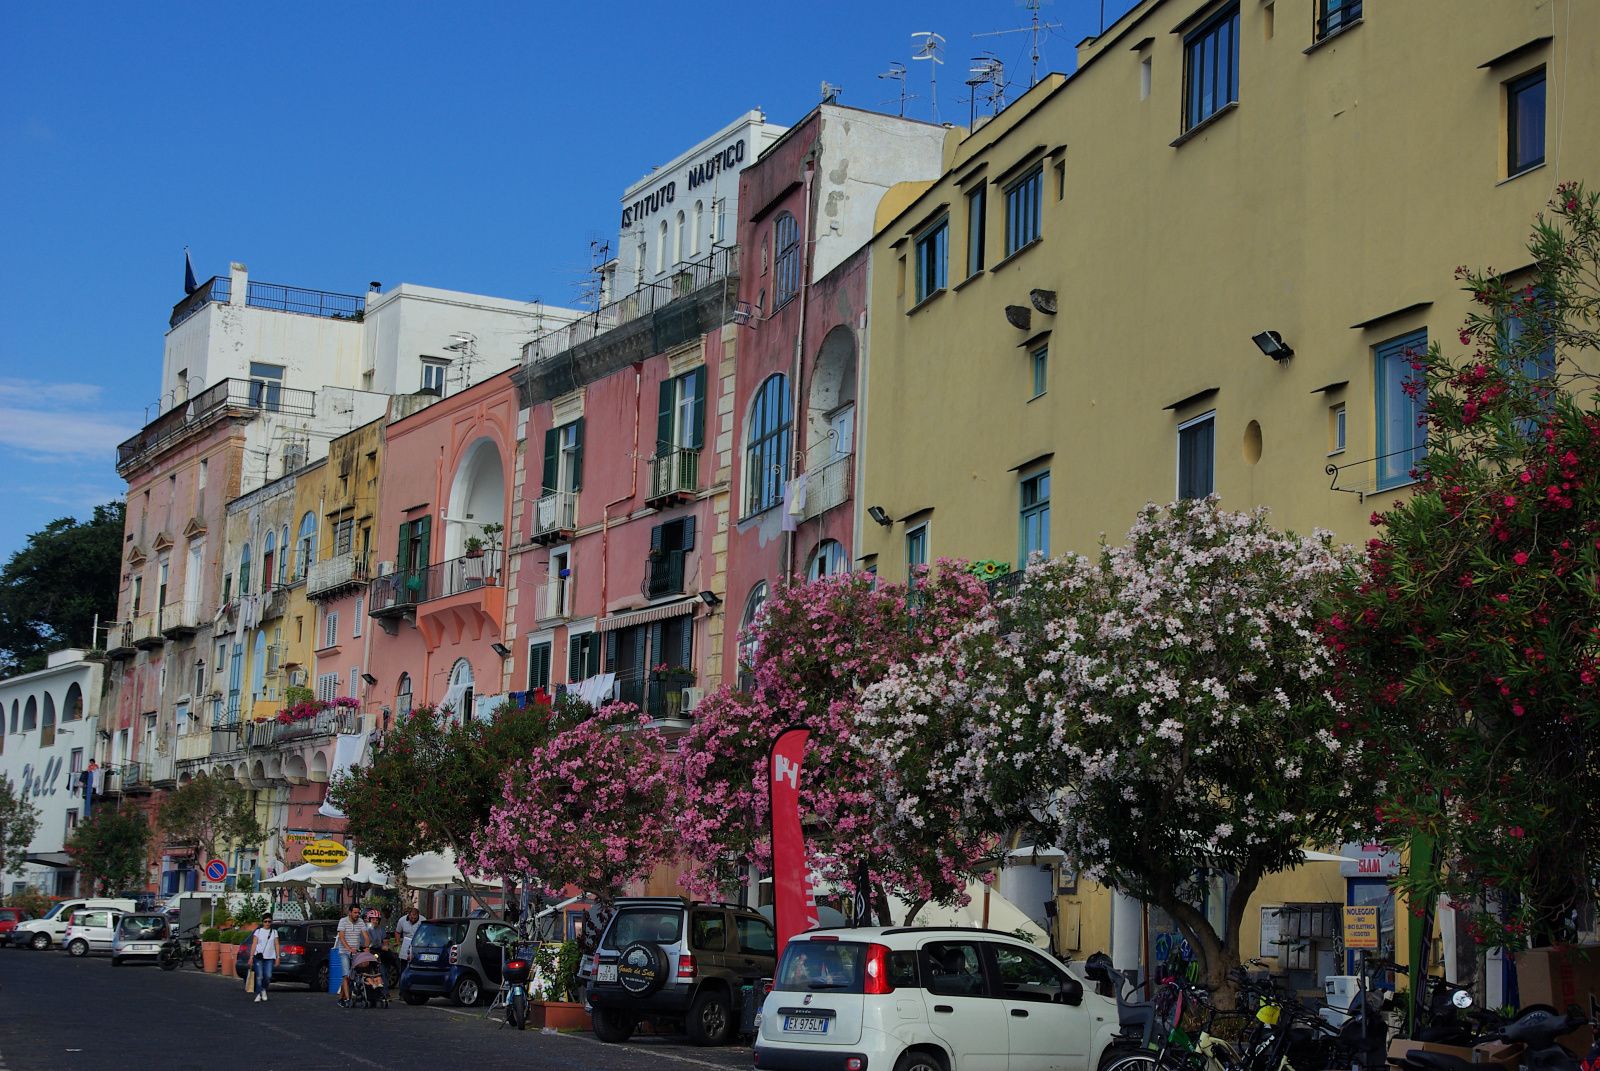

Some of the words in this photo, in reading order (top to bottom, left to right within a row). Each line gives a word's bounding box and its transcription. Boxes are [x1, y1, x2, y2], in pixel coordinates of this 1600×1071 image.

[621, 181, 676, 228] ISTITUTO
[688, 139, 745, 190] NAUTICO
[1359, 858, 1381, 873] SLAM
[789, 1018, 799, 1030] EX
[800, 1018, 824, 1031] 975LM
